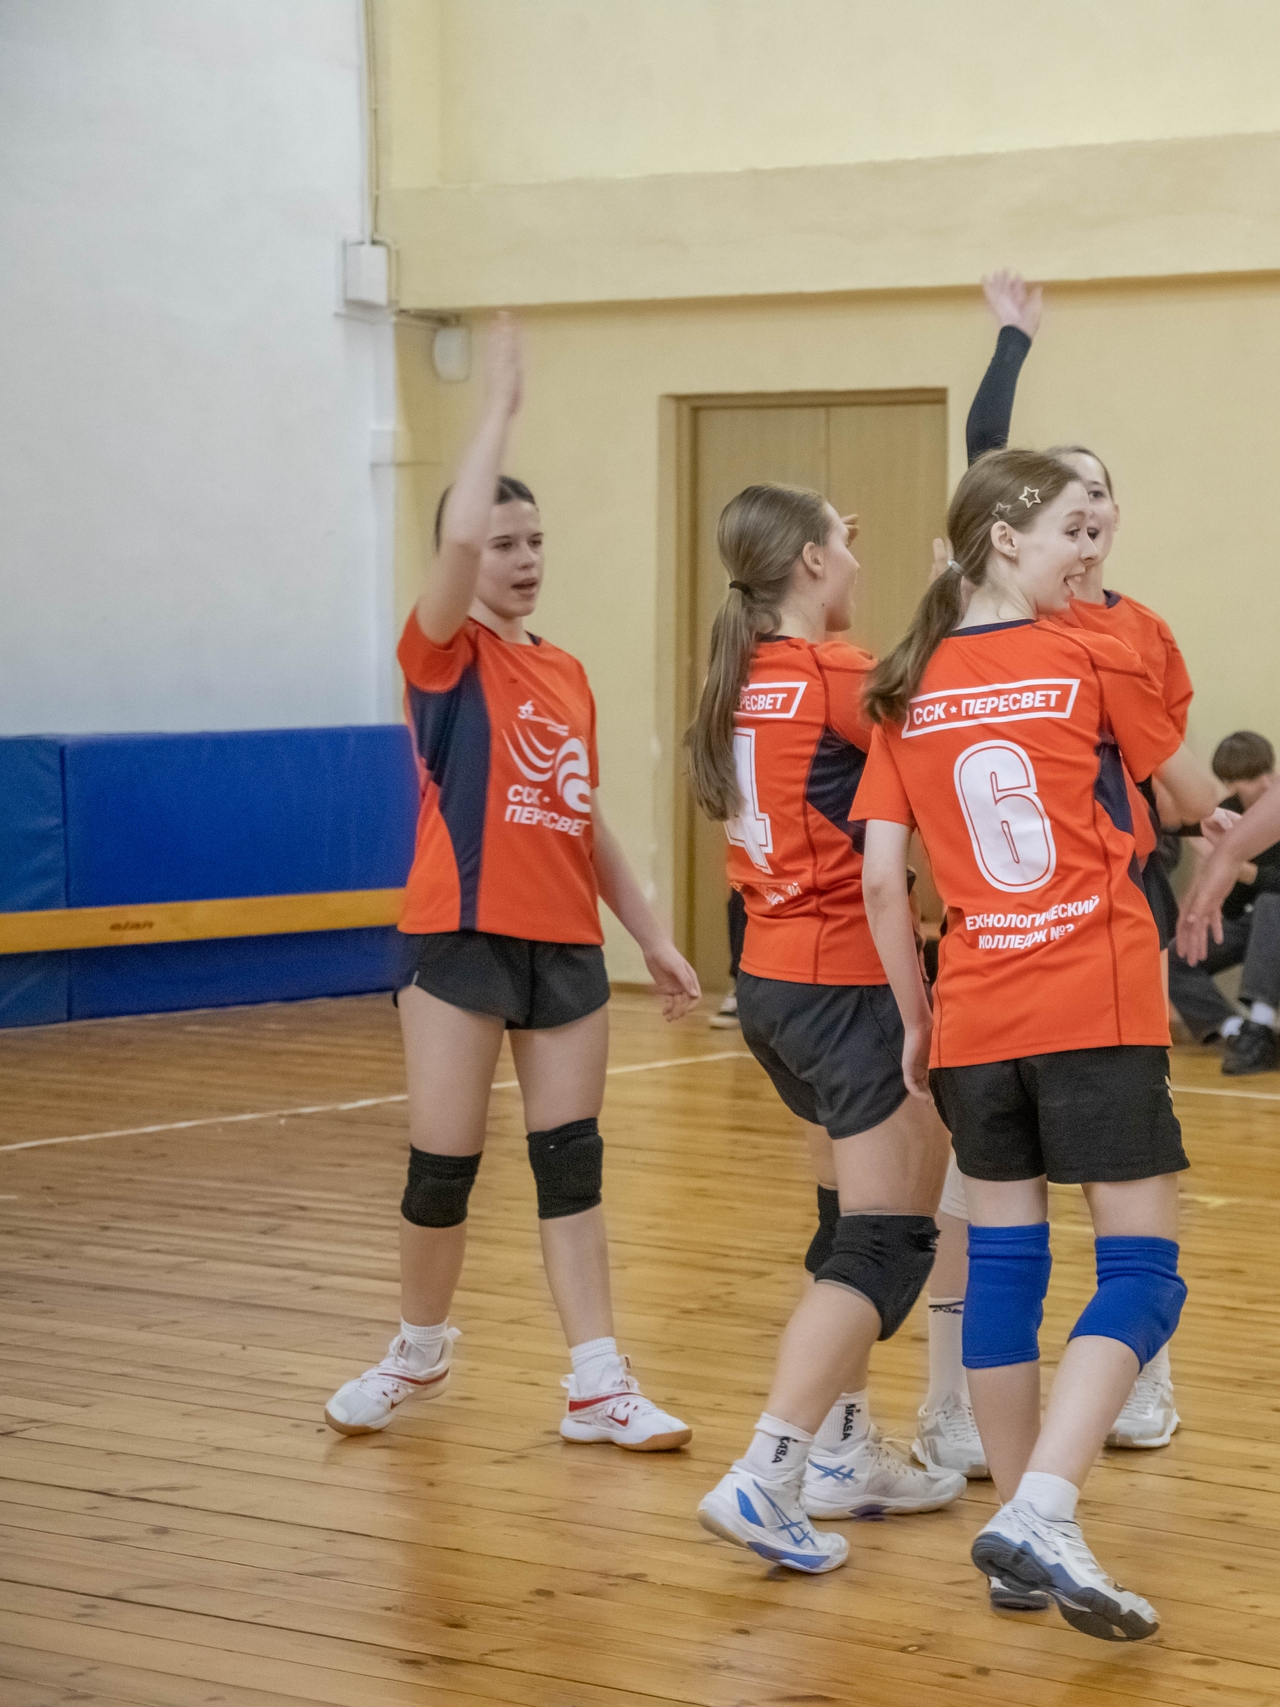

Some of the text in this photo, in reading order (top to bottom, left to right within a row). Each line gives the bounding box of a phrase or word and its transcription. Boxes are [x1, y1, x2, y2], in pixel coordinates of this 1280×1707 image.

[739, 692, 788, 711] РЕСВЕТ
[913, 690, 1061, 725] ССК ПЕРЕСВЕТ
[507, 784, 543, 806] ССК
[953, 739, 1057, 893] 6
[965, 894, 1100, 931] ЕХНОЛОГИЧЕСКИЙ
[978, 928, 1048, 950] КОЛЛЕДЖ
